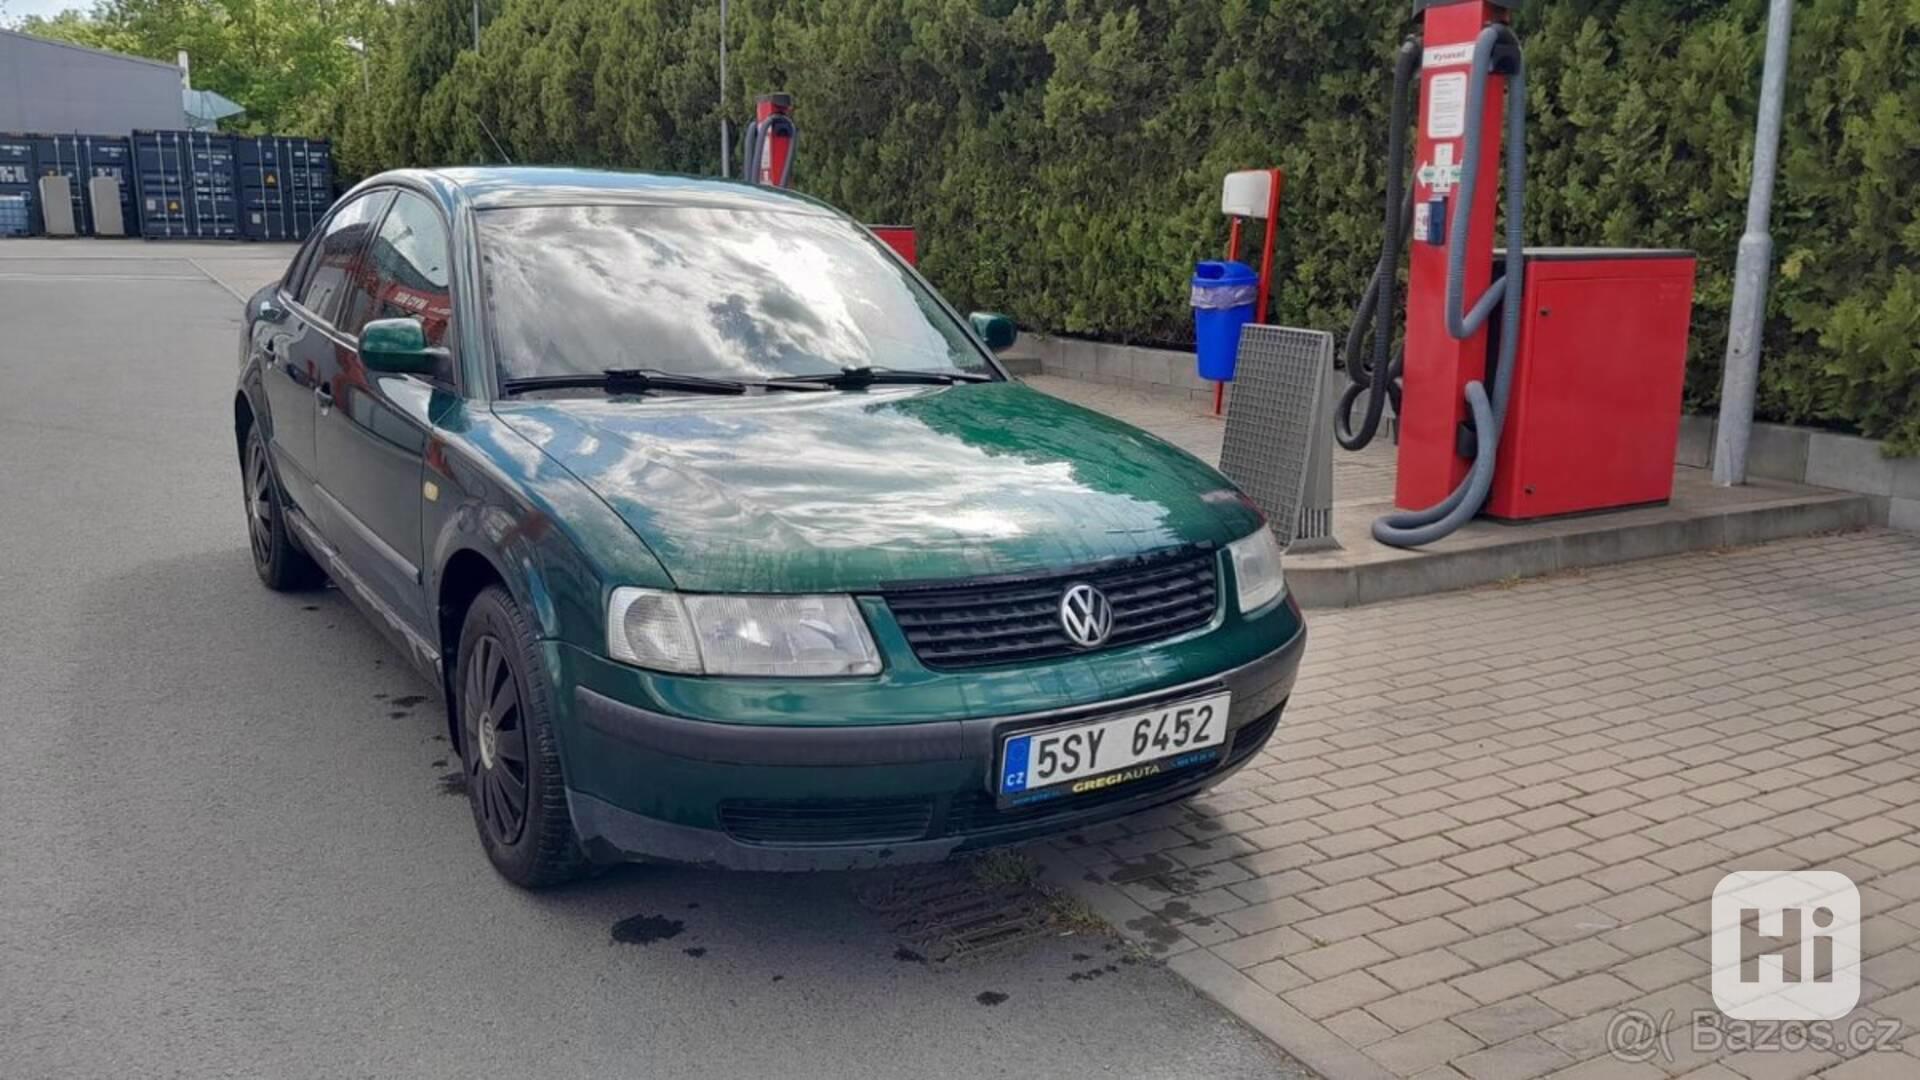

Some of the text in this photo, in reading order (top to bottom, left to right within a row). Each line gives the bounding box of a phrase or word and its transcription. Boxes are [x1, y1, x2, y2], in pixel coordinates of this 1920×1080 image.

[1037, 704, 1213, 780] 5SY 6452
[1006, 771, 1025, 786] CZ
